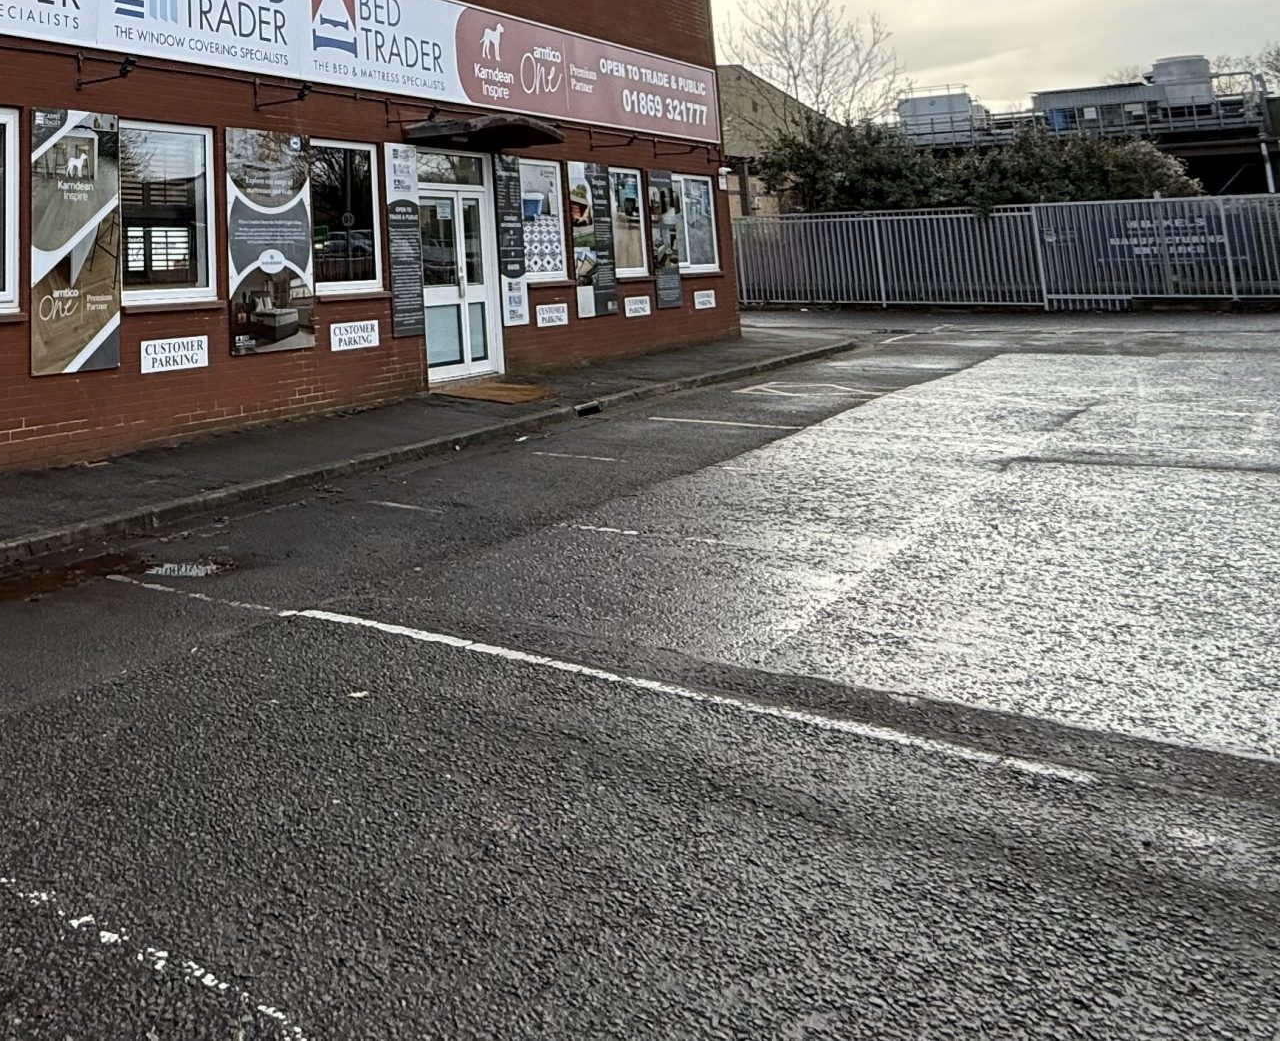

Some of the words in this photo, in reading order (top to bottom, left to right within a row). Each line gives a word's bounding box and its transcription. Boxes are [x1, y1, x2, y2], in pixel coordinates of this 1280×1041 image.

[114, 25, 134, 40] THE
[136, 29, 186, 48] WINDOW
[188, 38, 238, 57] COVERING
[240, 47, 289, 66] SPECIALISTS
[360, 27, 444, 74] TRADER
[533, 46, 562, 63] amtico
[313, 60, 330, 73] THE
[332, 63, 349, 75] BED
[351, 67, 358, 77] &
[360, 68, 400, 83] MATTRESS
[402, 75, 445, 91] SPECIALISTS
[474, 63, 514, 84] Karndean
[520, 52, 563, 95] One
[599, 58, 626, 78] OPEN
[626, 65, 640, 81] TO
[640, 68, 670, 88] TRADE
[671, 75, 678, 89] &
[678, 77, 706, 96] PUBLIC
[482, 80, 509, 100] Inspire
[622, 88, 663, 118] 01869
[665, 97, 708, 126] 321777
[57, 180, 94, 191] Karndean
[63, 191, 89, 202] Inspire
[52, 288, 79, 297] amtico
[39, 295, 79, 321] One
[538, 305, 566, 316] CUSTOMER
[541, 314, 564, 324] PARKING
[333, 322, 376, 337] CUSTOMER
[145, 339, 204, 356] CUSTOMER
[338, 334, 372, 348] PARKING
[151, 352, 199, 369] PARKING
